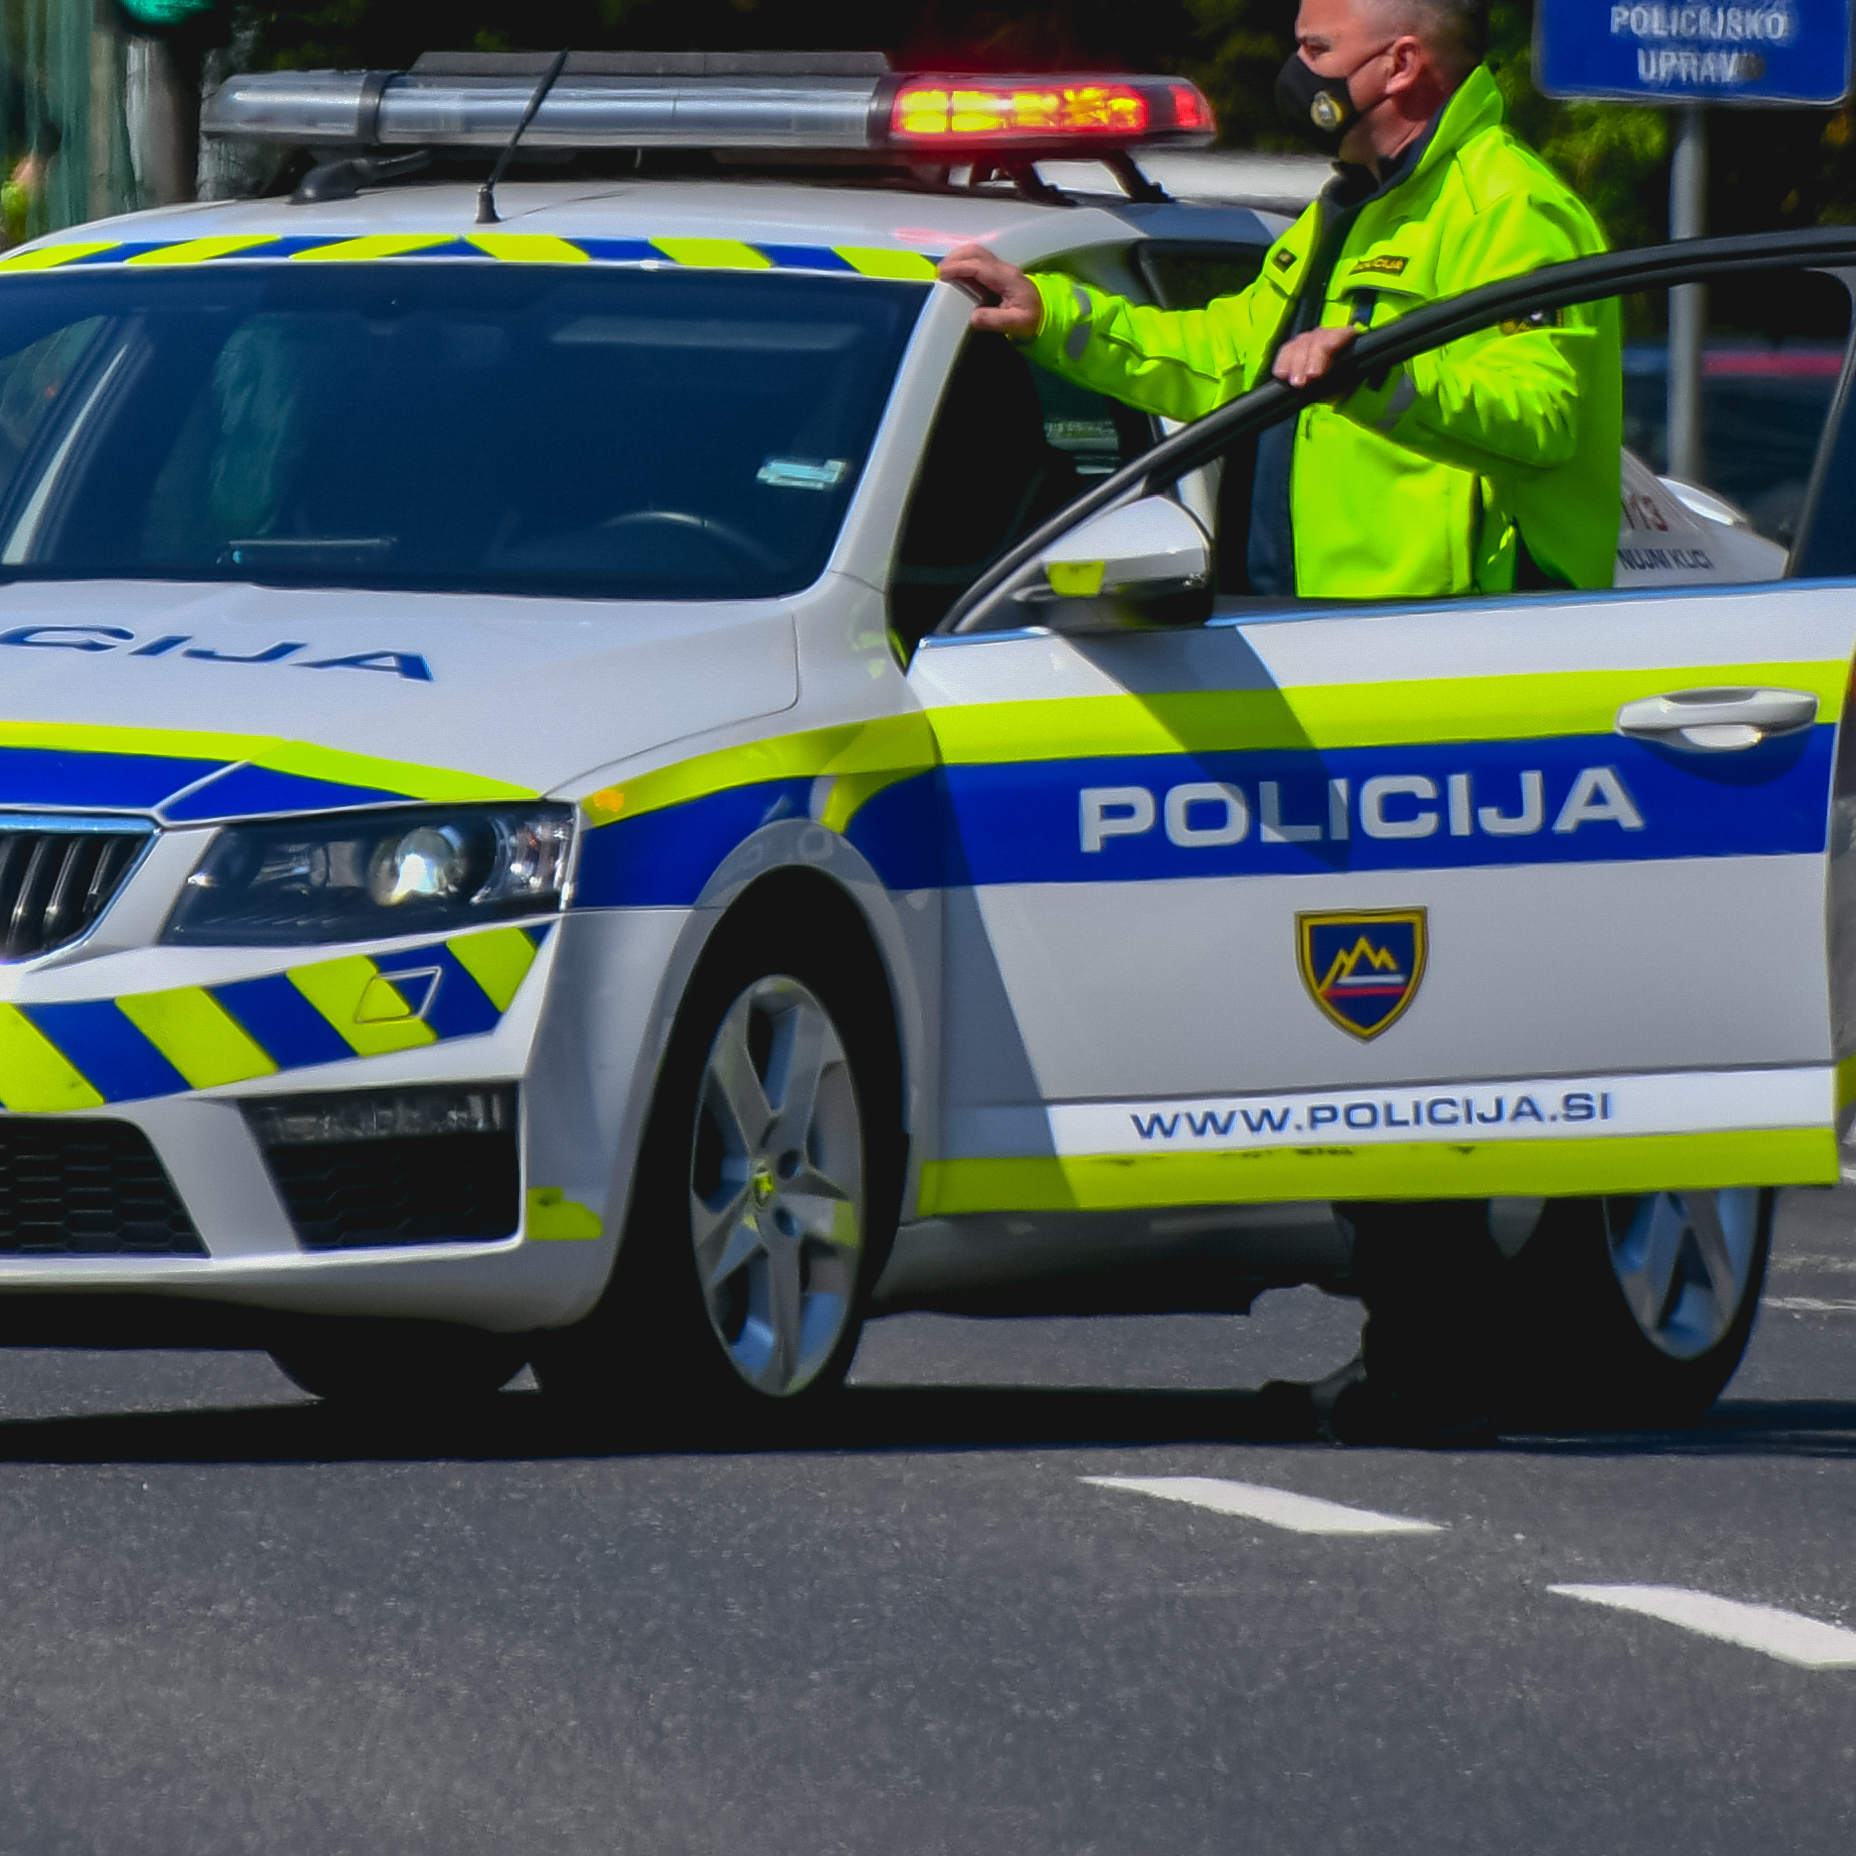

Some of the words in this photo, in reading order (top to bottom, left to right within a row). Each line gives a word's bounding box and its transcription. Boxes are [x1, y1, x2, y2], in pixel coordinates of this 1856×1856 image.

[1610, 4, 1790, 41] POLICIJSKO
[1637, 46, 1764, 86] UPRAV
[1078, 765, 1645, 854] POLICIJA
[1130, 1091, 1611, 1141] WWW.POLICIJA.SI
